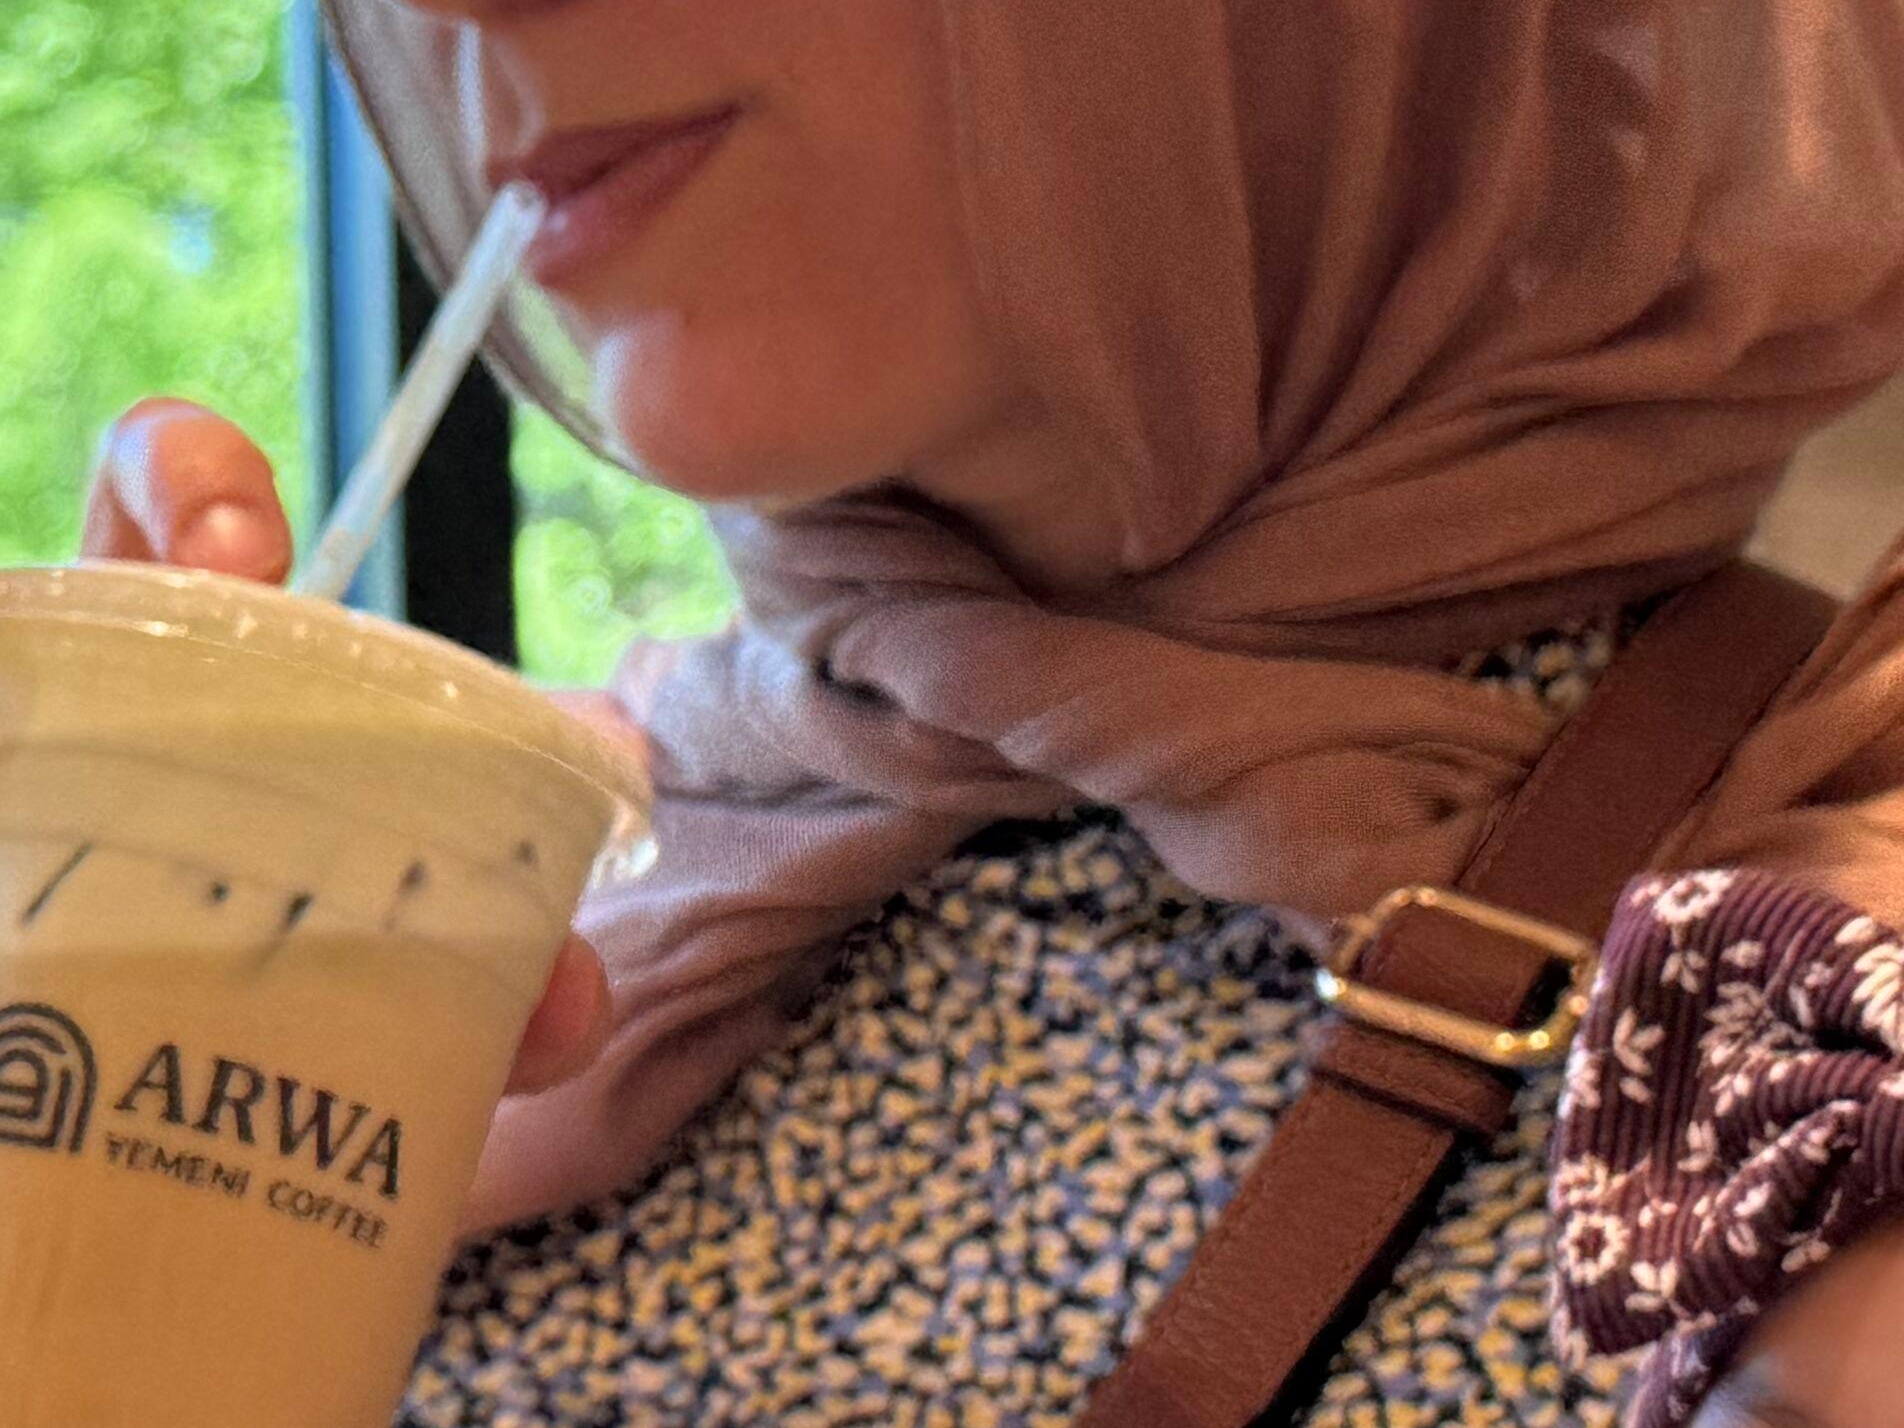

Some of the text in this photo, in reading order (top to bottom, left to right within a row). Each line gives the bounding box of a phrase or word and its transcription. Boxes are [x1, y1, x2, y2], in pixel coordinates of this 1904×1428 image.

[113, 1041, 403, 1200] ARWA
[107, 1134, 388, 1249] YEMENI COFFEE
